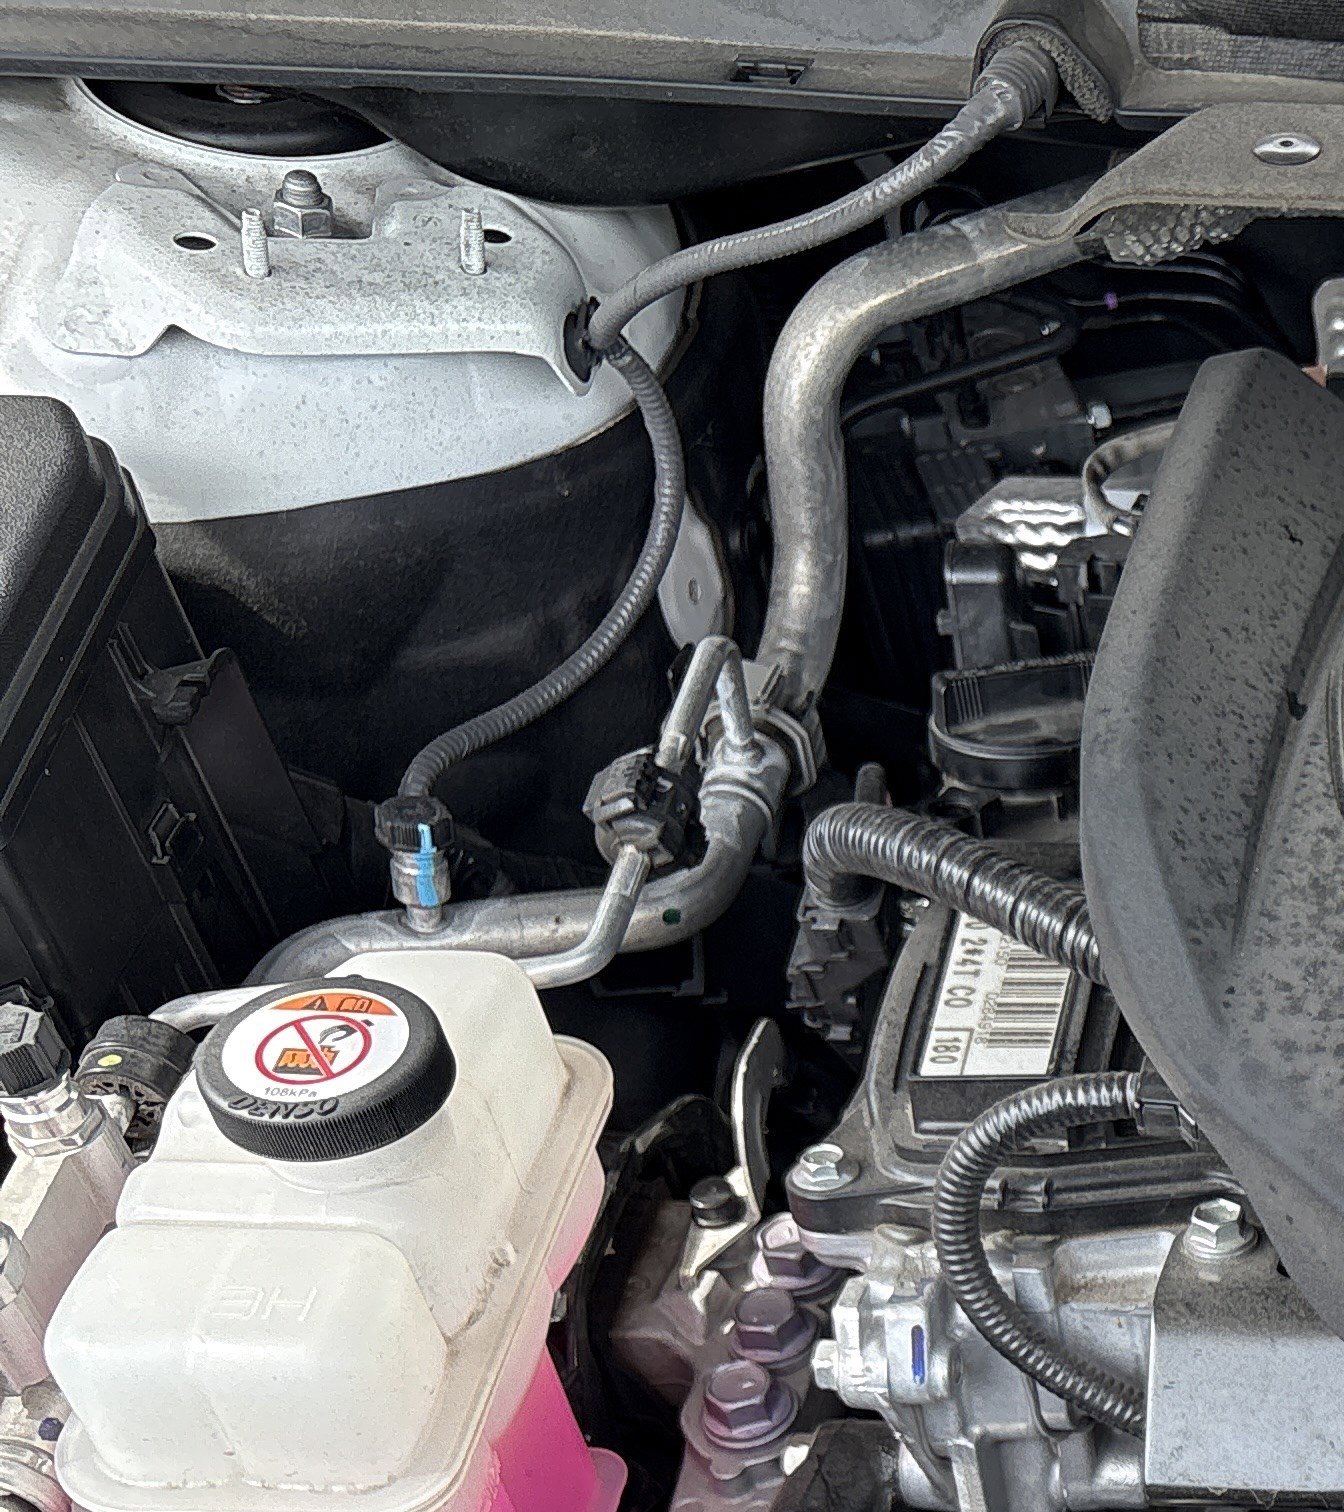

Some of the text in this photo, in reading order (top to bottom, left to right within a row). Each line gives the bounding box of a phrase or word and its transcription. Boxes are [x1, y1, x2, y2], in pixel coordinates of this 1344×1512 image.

[929, 1037, 962, 1064] 180
[264, 1086, 317, 1098] 108kPa
[228, 1095, 340, 1119] DENSO
